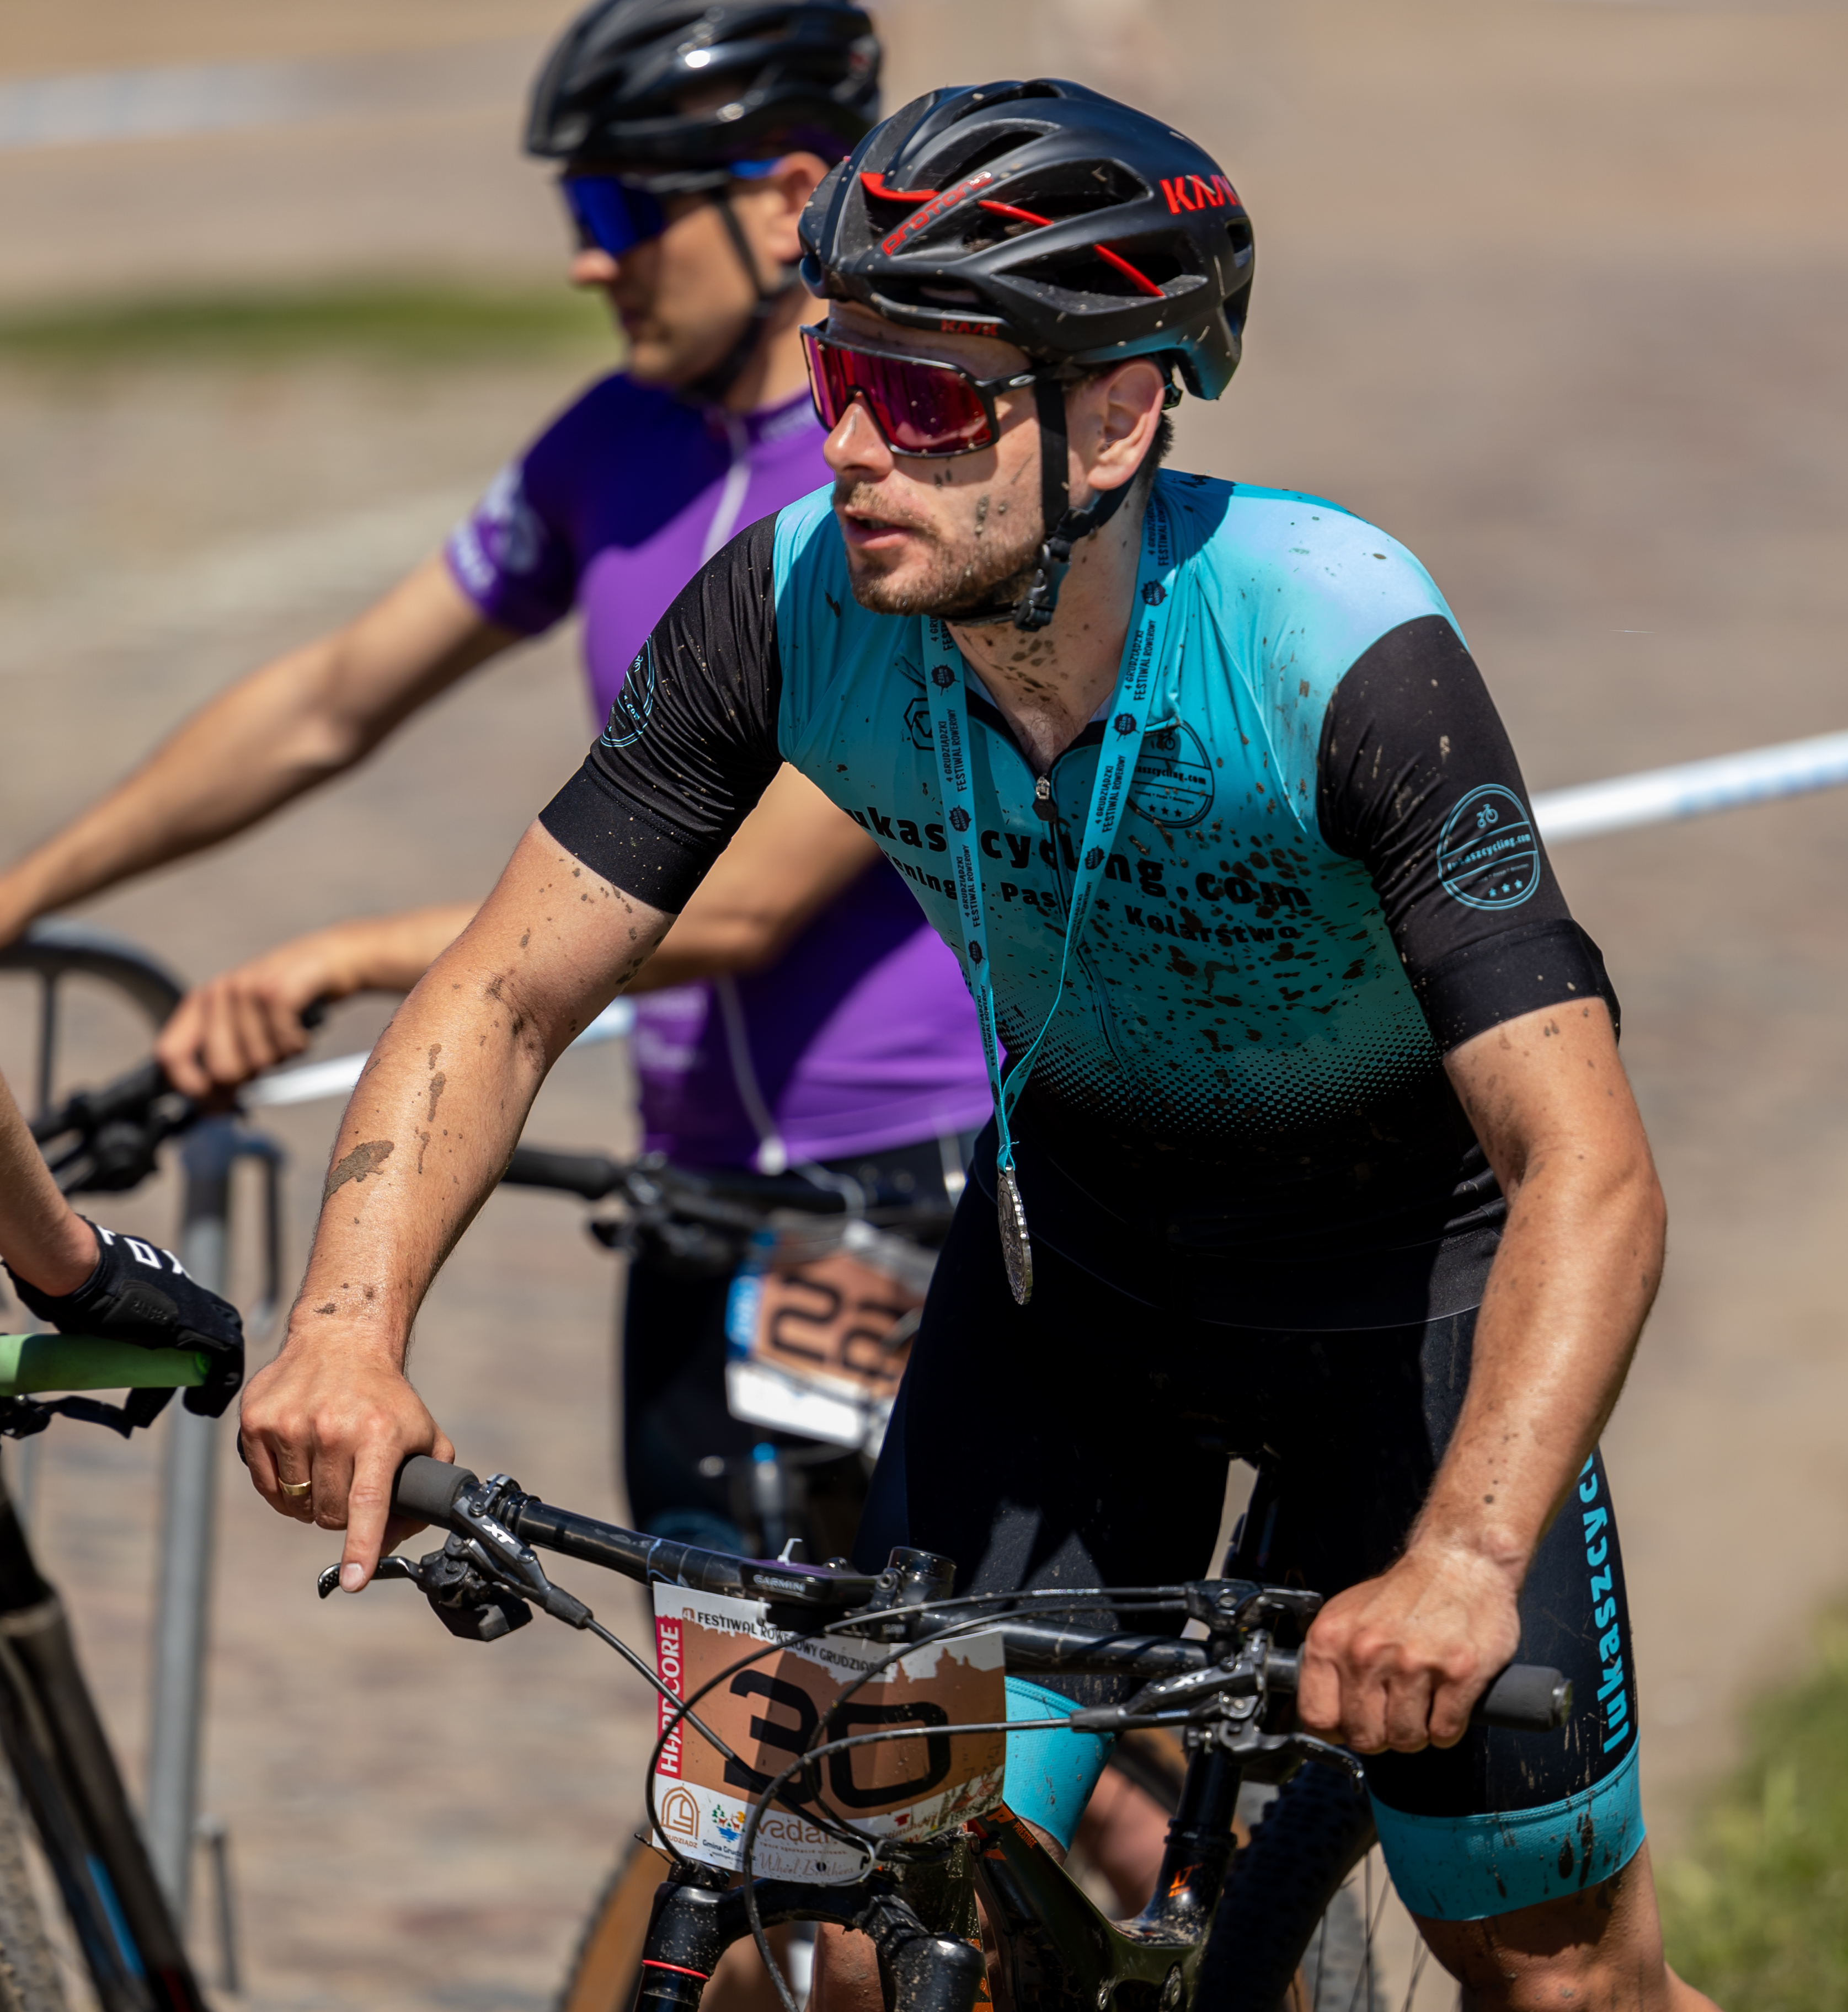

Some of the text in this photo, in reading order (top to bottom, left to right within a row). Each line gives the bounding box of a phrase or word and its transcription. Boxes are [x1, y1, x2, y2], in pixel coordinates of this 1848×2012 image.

[941, 319, 998, 336] KASK
[1157, 525, 1169, 566] FESTIWAL
[1134, 619, 1156, 700] FESTIWAL ROWEROWY
[946, 708, 967, 793] FESTIWAL ROWEROWY
[1102, 754, 1126, 833] FESTIWAL ROWEROWY
[962, 844, 981, 928] FESTIWAL ROWEROWY
[1124, 905, 1298, 943] Kolarstwo
[980, 983, 996, 1067] FESTIWAL ROWEROWY
[482, 1523, 516, 1544] XT
[753, 1574, 806, 1593] GARMIN
[697, 1612, 757, 1635] FESTIWAL
[724, 1669, 951, 1808] 30
[1012, 1821, 1038, 1849] PRESTIGE
